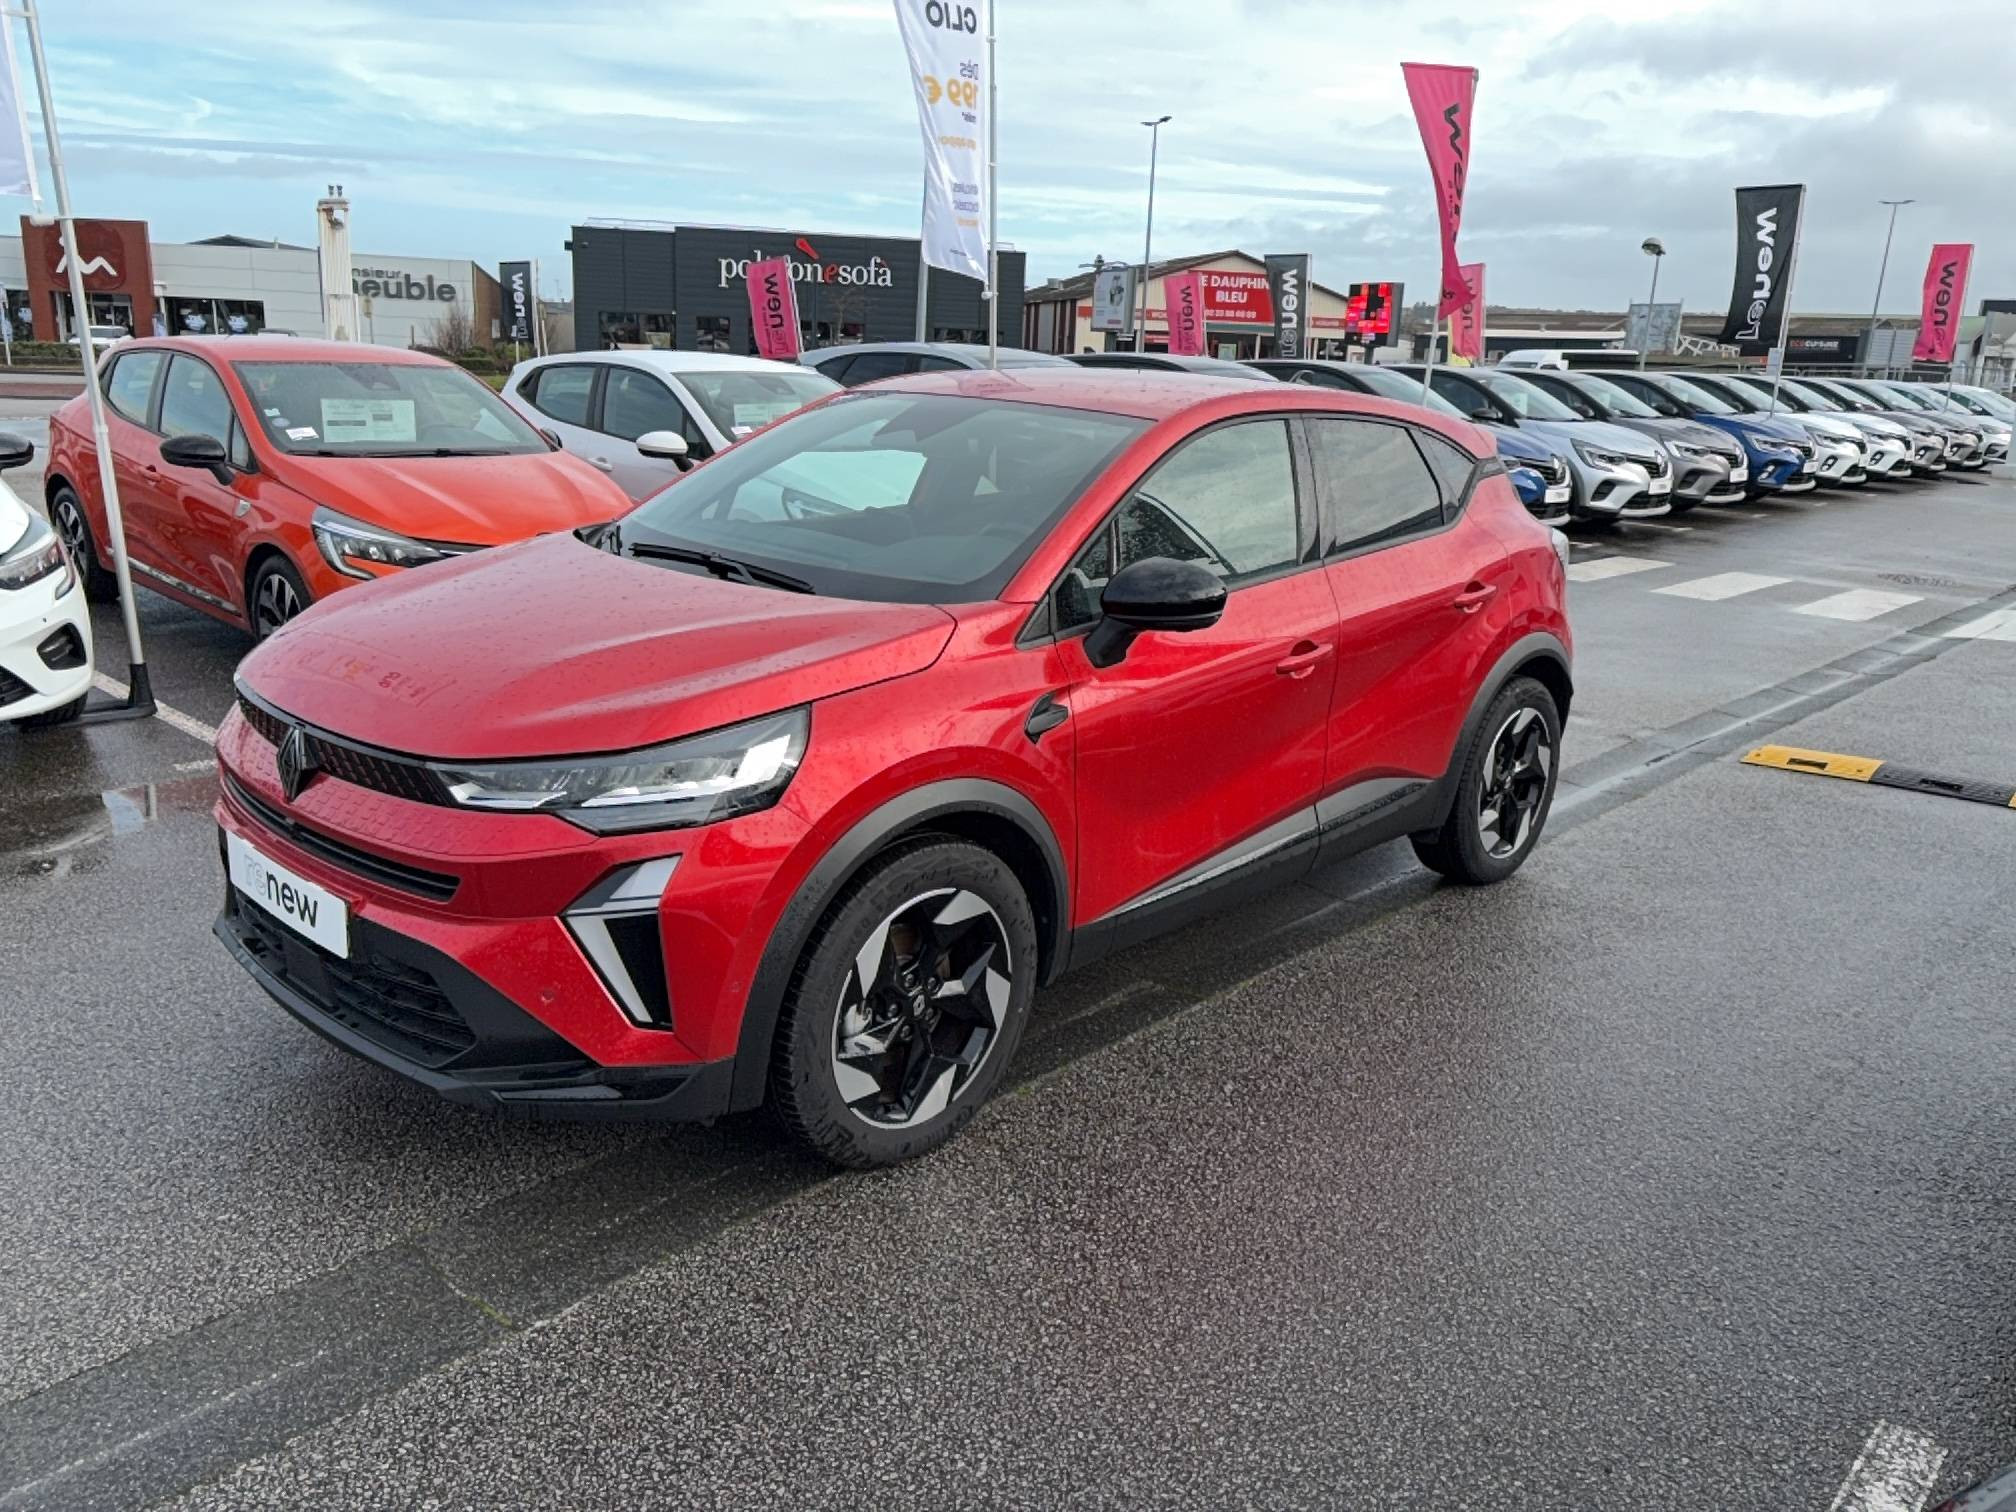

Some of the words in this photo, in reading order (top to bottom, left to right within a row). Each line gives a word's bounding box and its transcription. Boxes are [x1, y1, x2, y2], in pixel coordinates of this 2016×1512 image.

[351, 266, 401, 279] nsieur
[718, 249, 893, 288] poonesofà
[351, 273, 457, 302] euble
[1211, 275, 1269, 290] DAUPHIN
[1216, 290, 1249, 304] BLEU
[243, 853, 318, 928] renew
